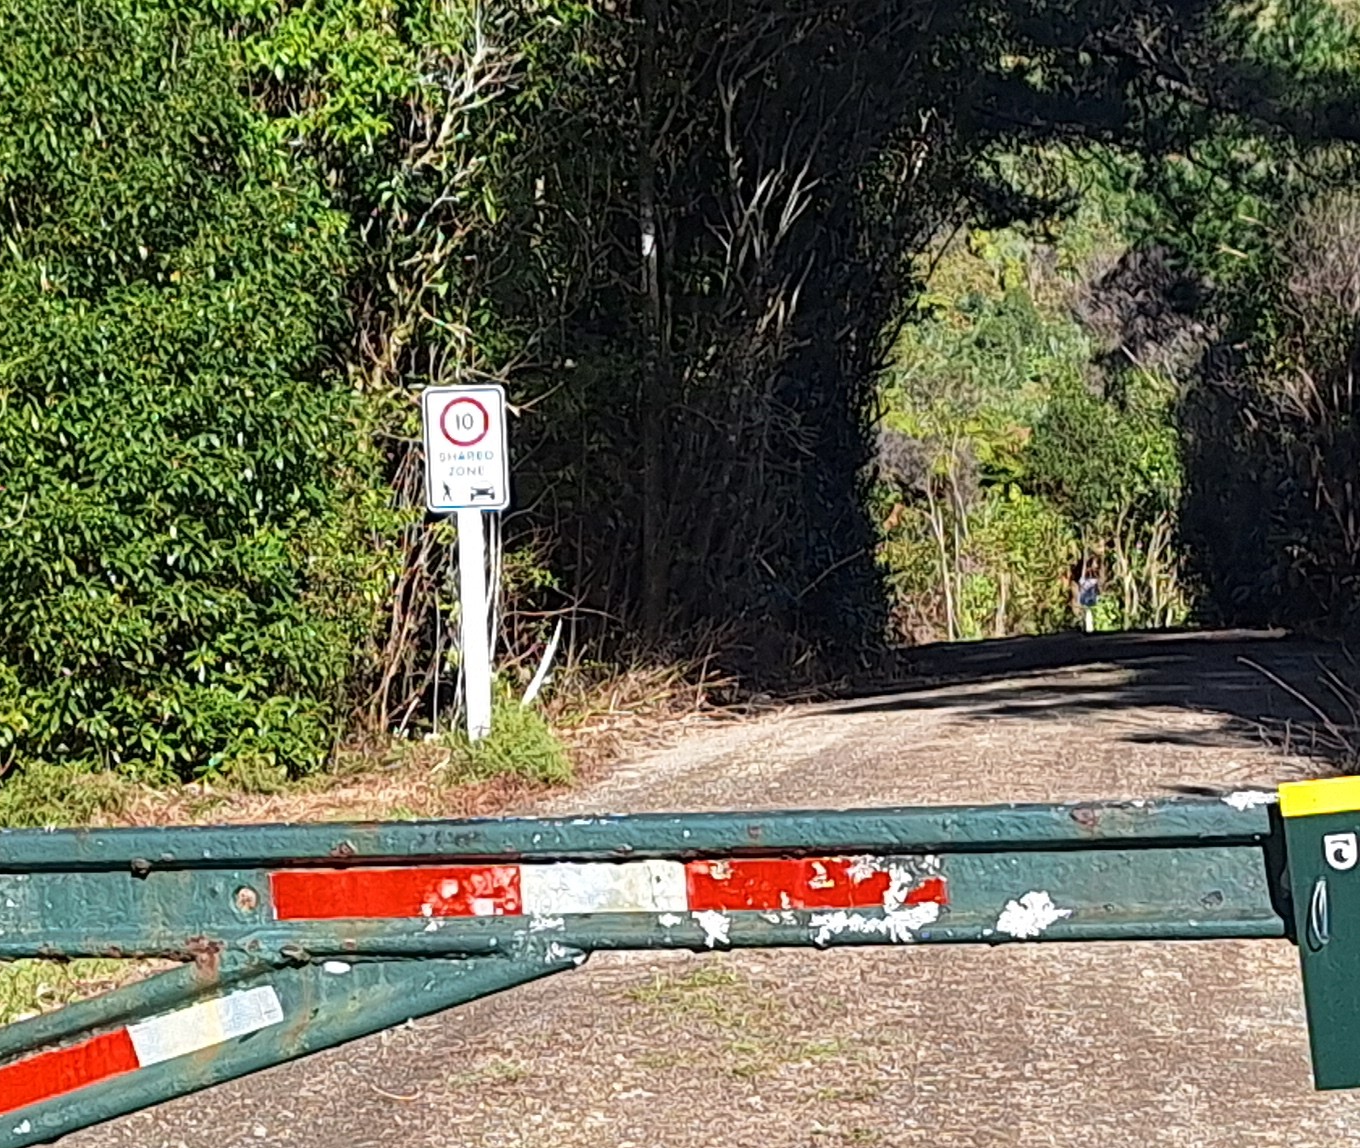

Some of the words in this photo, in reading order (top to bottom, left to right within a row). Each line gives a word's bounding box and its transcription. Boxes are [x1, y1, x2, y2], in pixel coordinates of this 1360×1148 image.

[455, 412, 474, 431] 10
[439, 450, 494, 462] SHARED
[448, 465, 484, 477] ZONE
